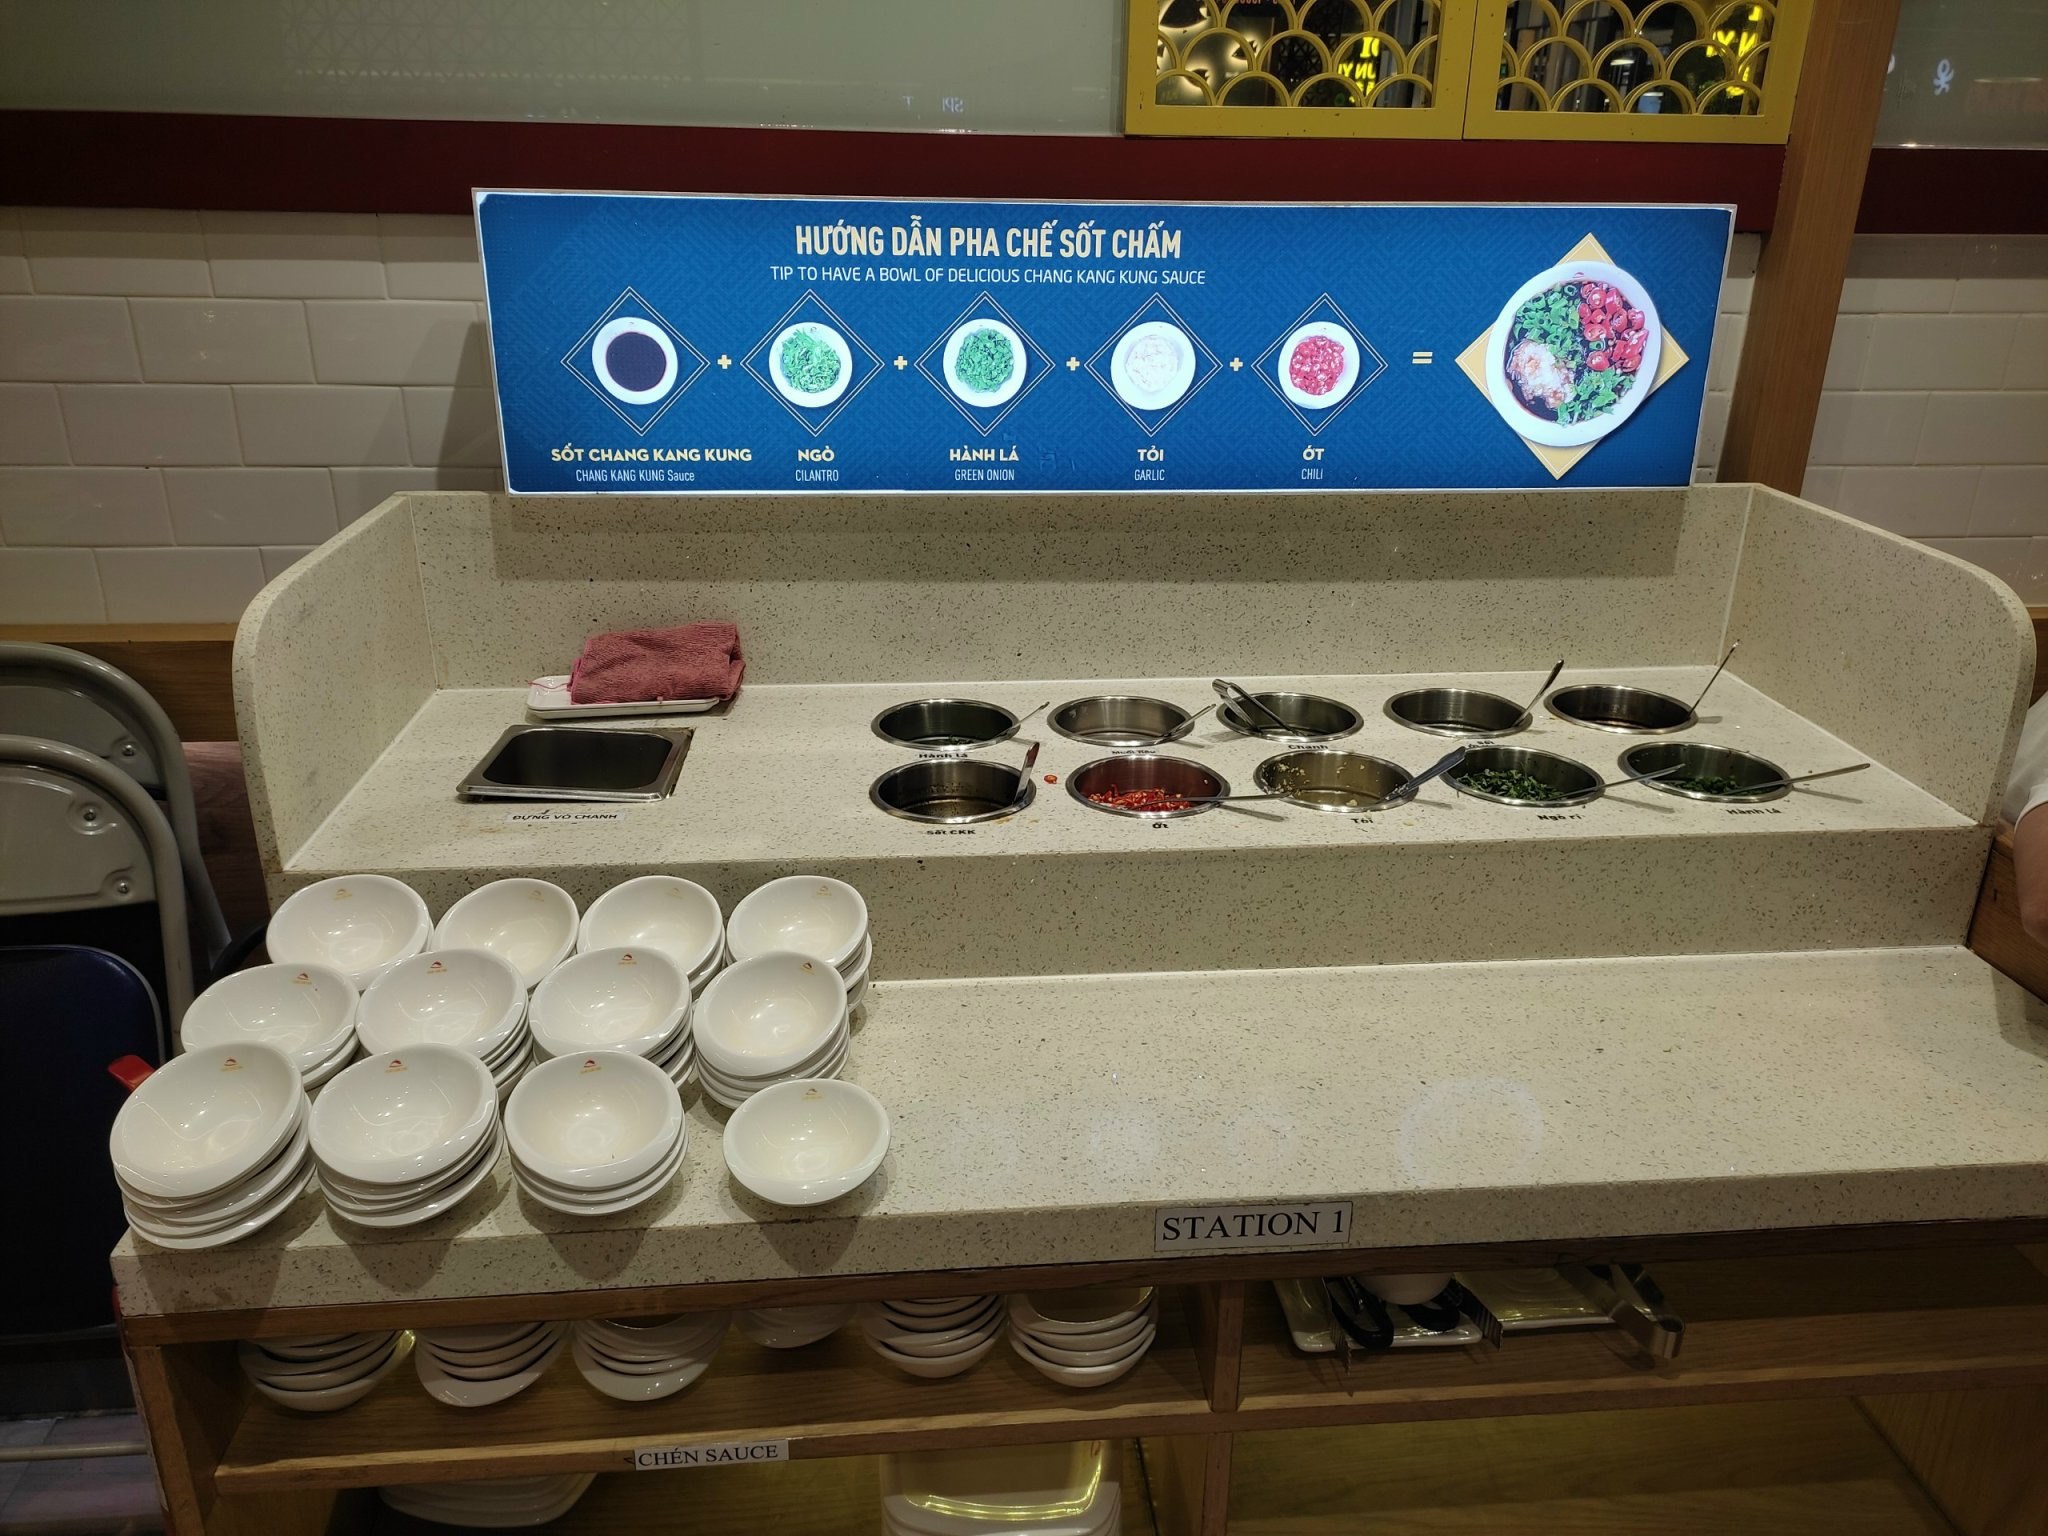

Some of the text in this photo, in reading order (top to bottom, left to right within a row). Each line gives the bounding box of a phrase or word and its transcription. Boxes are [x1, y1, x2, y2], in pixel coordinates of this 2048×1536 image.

[795, 215, 1182, 259] HƯỚNG DẪN PHA CHẾ SỐT CHẤM
[770, 266, 1206, 284] TIP TO HAVE A BOWL OF DELICIOUS CHANG KANG KUNG SAUCE
[551, 443, 752, 462] SỐT CHANG KANG KUNG
[797, 446, 835, 462] NGÒ
[949, 445, 1020, 461] HÀNH LÁ
[1137, 445, 1164, 461] TỎI
[1302, 445, 1324, 461] ỚT
[576, 469, 695, 482] CHANG KANG KUNG Sauce
[795, 470, 839, 482] CILANTRO
[954, 469, 1015, 481] GREEN ONION
[1134, 469, 1165, 481] GARLIC
[1301, 468, 1323, 480] CHILI
[1163, 1210, 1344, 1241] STATION 1
[638, 1445, 778, 1467] CHÉN SAUCE
